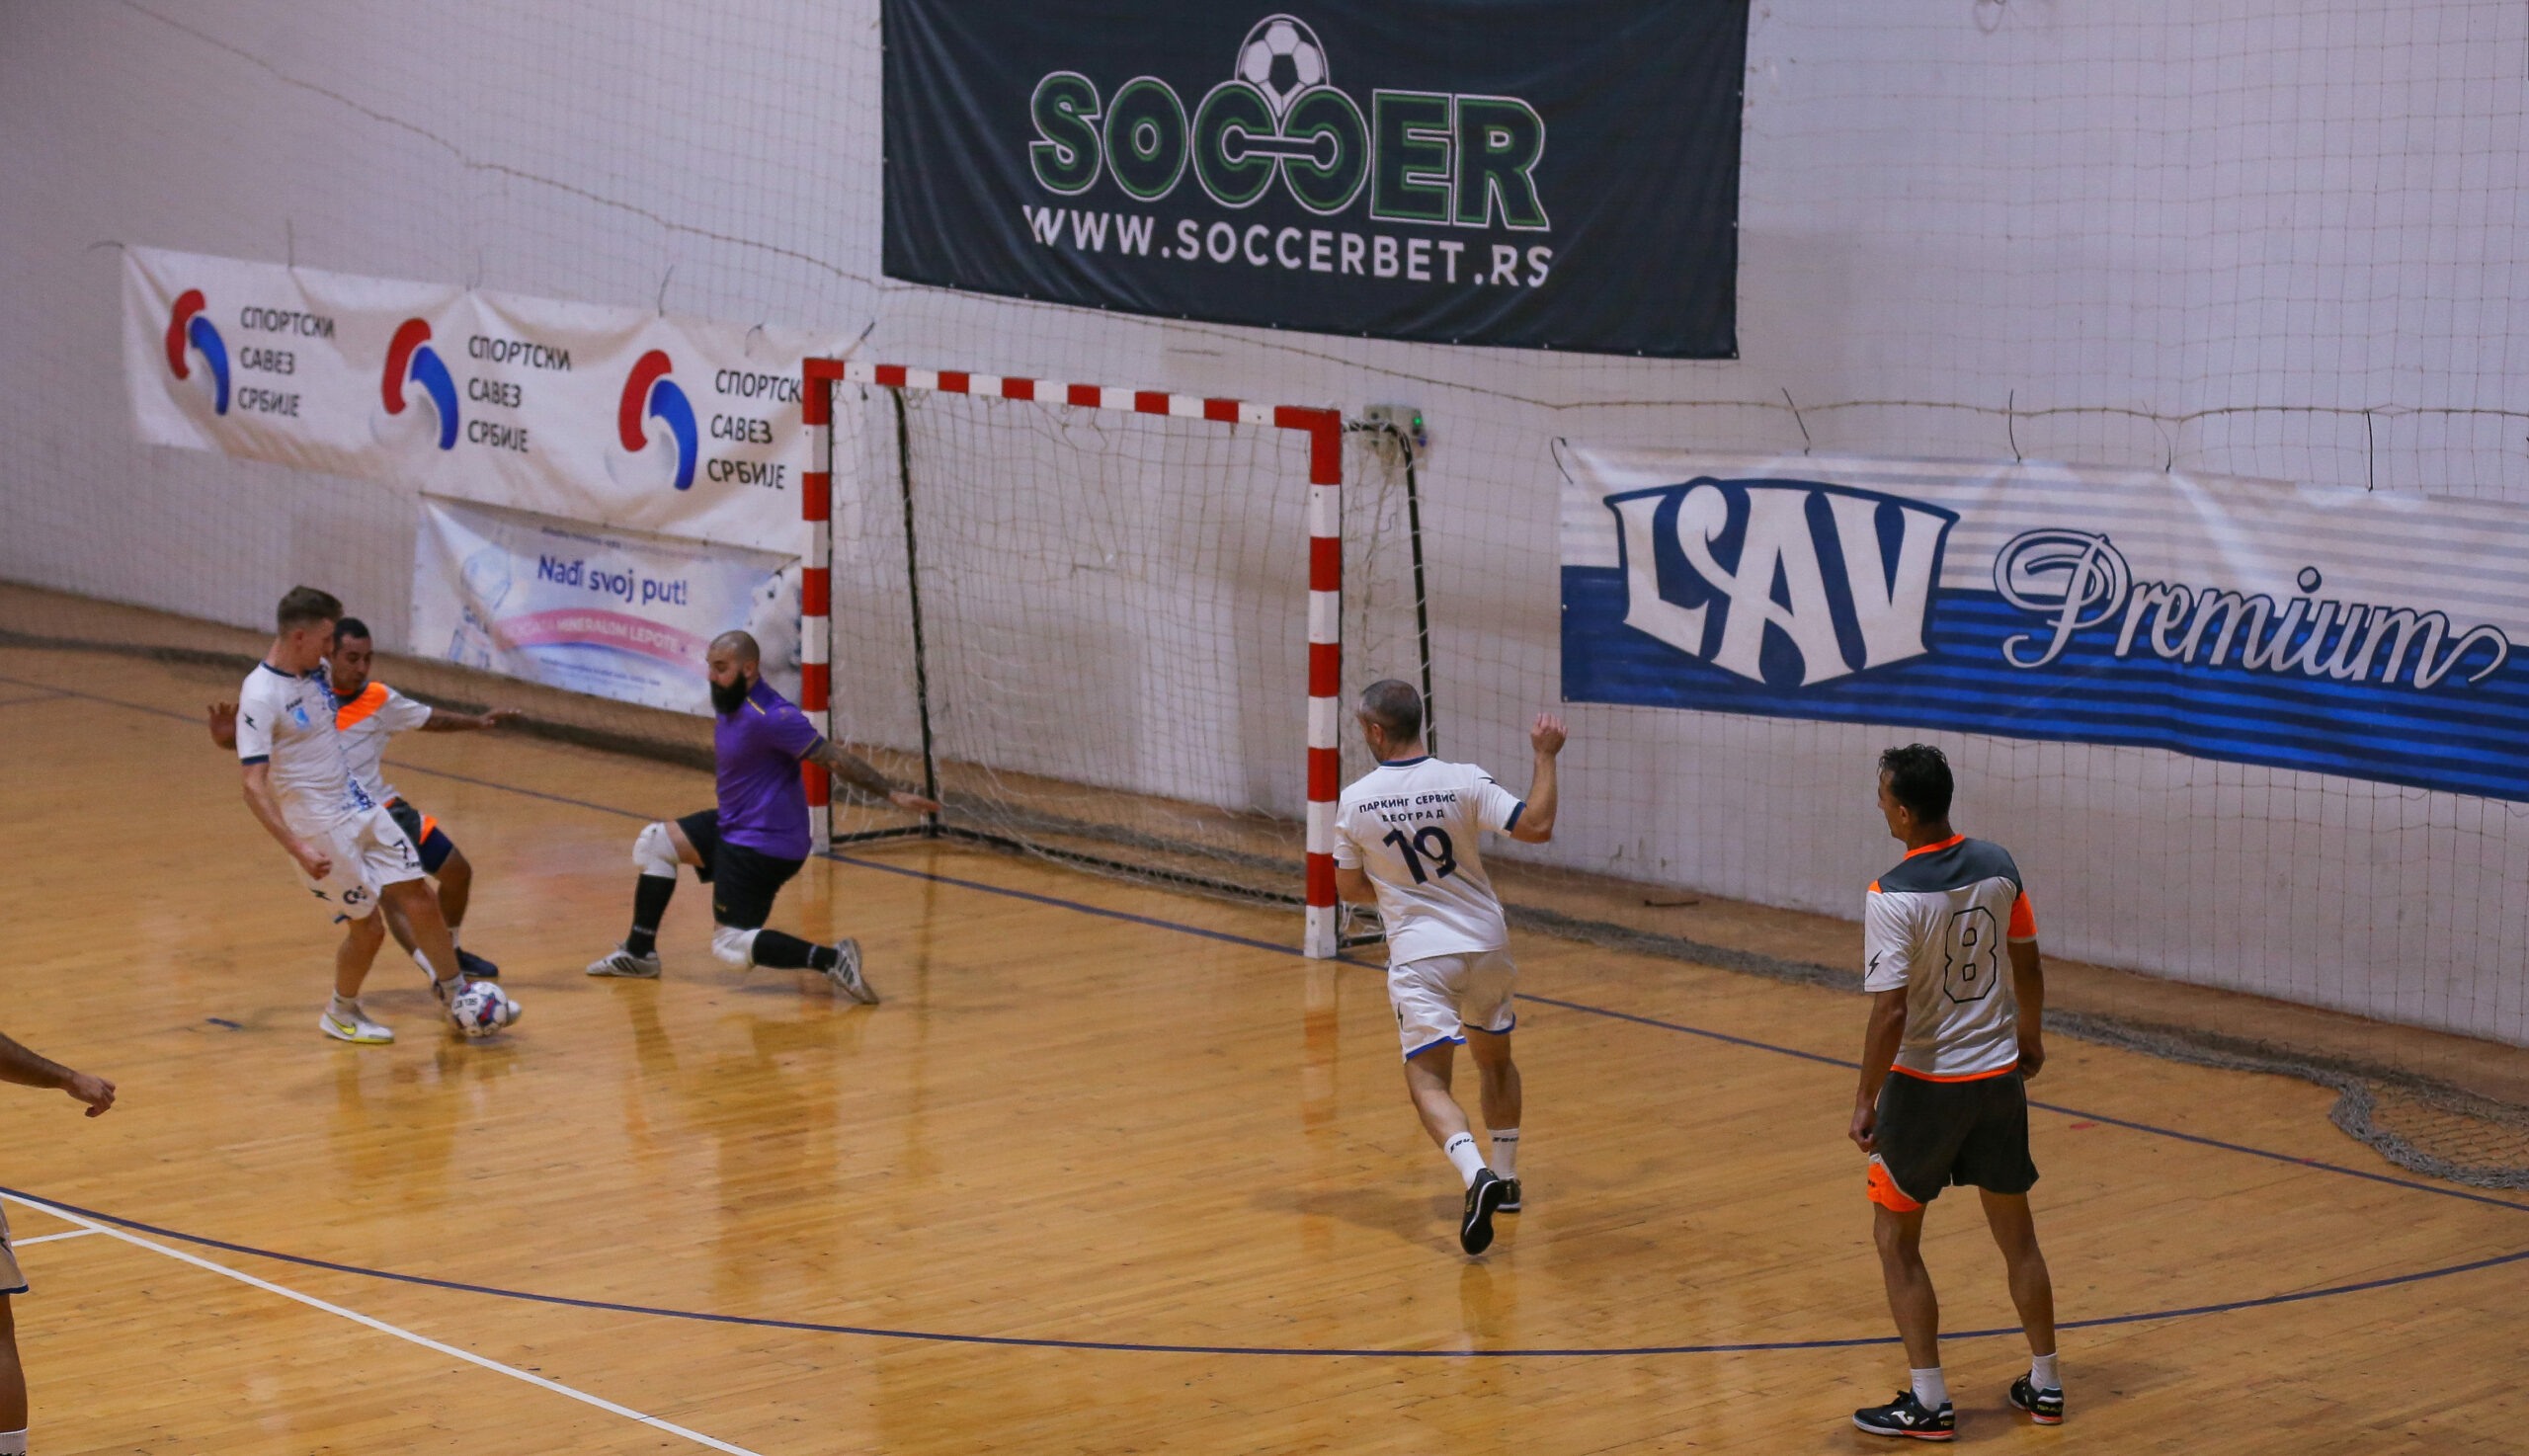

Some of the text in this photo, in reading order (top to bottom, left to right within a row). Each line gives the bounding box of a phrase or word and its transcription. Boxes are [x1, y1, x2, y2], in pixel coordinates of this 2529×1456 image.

[1029, 71, 1550, 231] SOCCER
[1022, 204, 1553, 287] WWW.SOCCERBET.RS
[240, 306, 335, 338] СПОРТСКИ
[240, 347, 294, 375] САВЕЗ
[469, 335, 571, 371] СПОРТСКИ
[238, 387, 299, 417] СРБИЈЕ
[469, 377, 522, 408] САВЕЗ
[715, 368, 802, 403] СПОРТСК
[468, 420, 529, 452] СРБИЈЕ
[711, 414, 773, 444] САВЕЗ
[707, 458, 785, 489] СРБИЈЕ
[537, 553, 688, 606] Nađi svoj put!
[1610, 479, 2509, 688] LAV Premium
[1359, 793, 1456, 813] ПАРКИНГ СЕРВИС
[1382, 826, 1457, 885] 19
[1944, 907, 1997, 1004] 8
